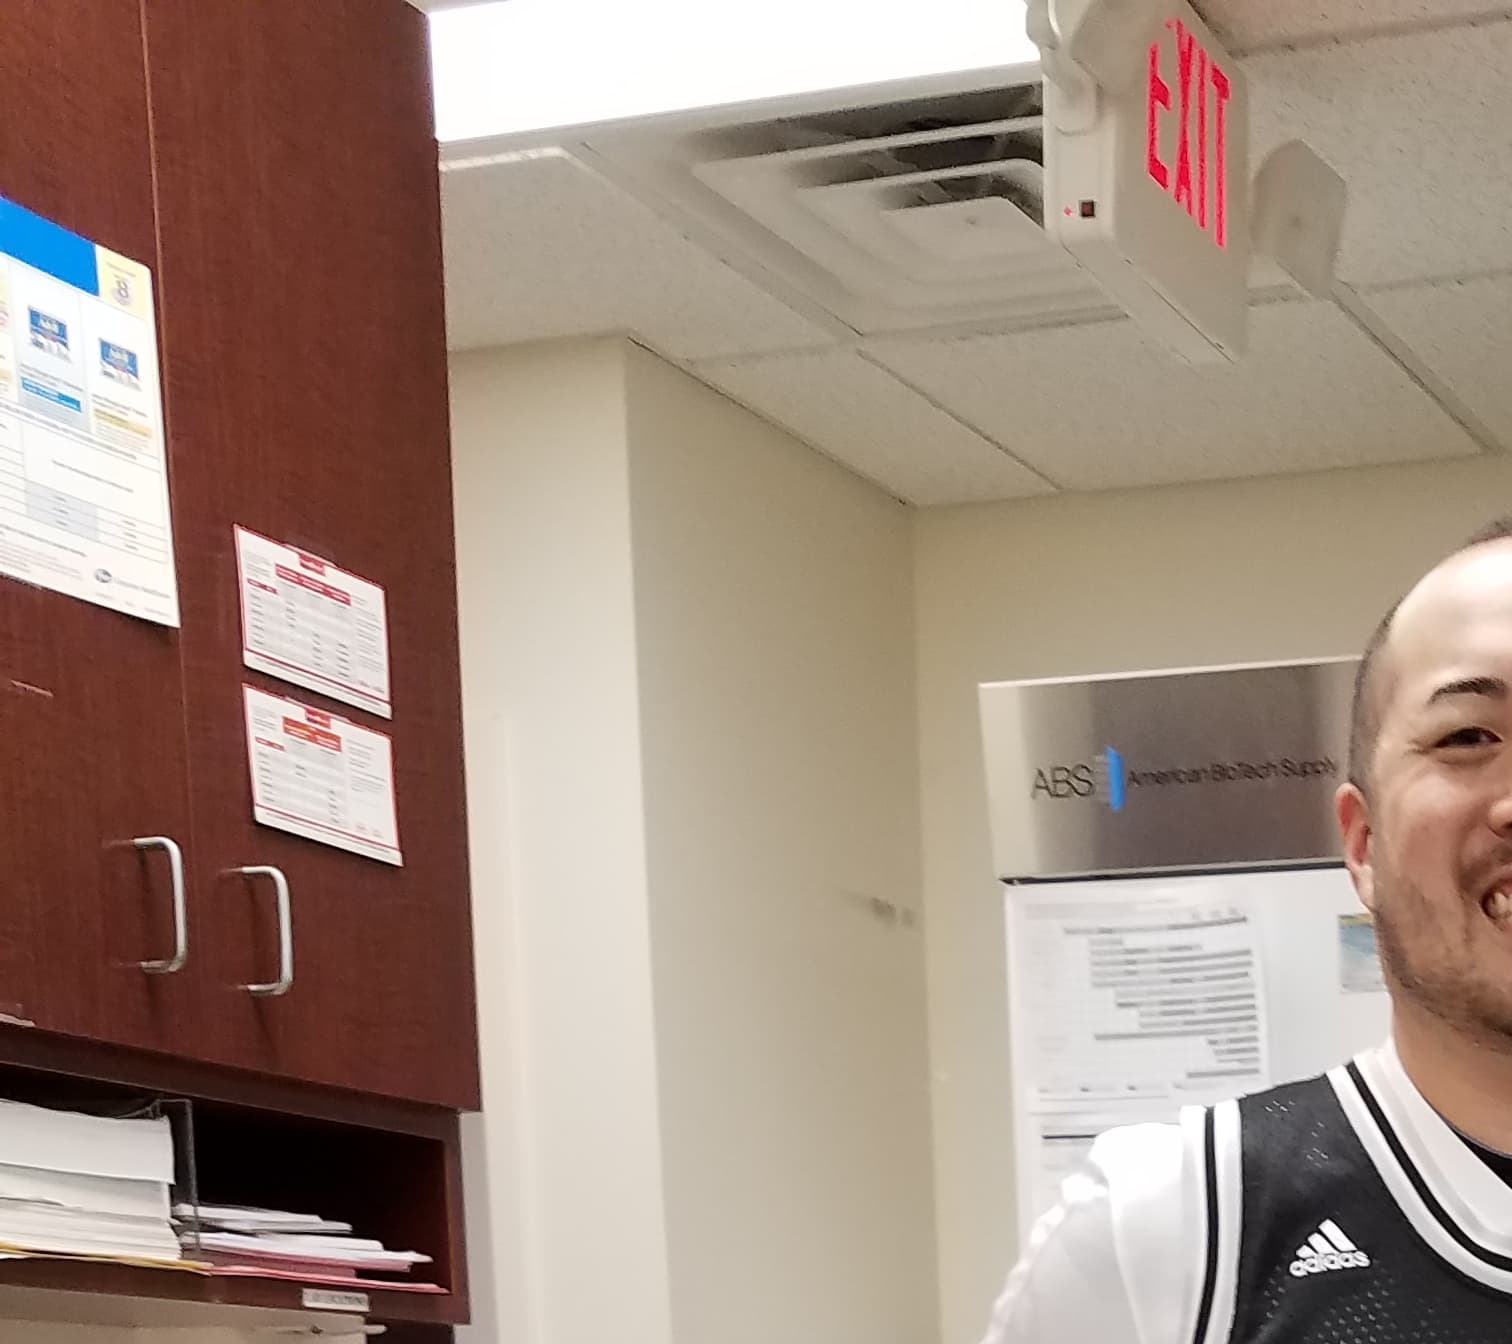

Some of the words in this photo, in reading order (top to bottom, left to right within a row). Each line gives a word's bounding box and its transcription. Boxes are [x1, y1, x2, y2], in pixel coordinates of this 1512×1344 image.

[1146, 18, 1231, 249] EXIT
[1031, 763, 1096, 799] ABS
[1289, 1249, 1371, 1277] adidas
